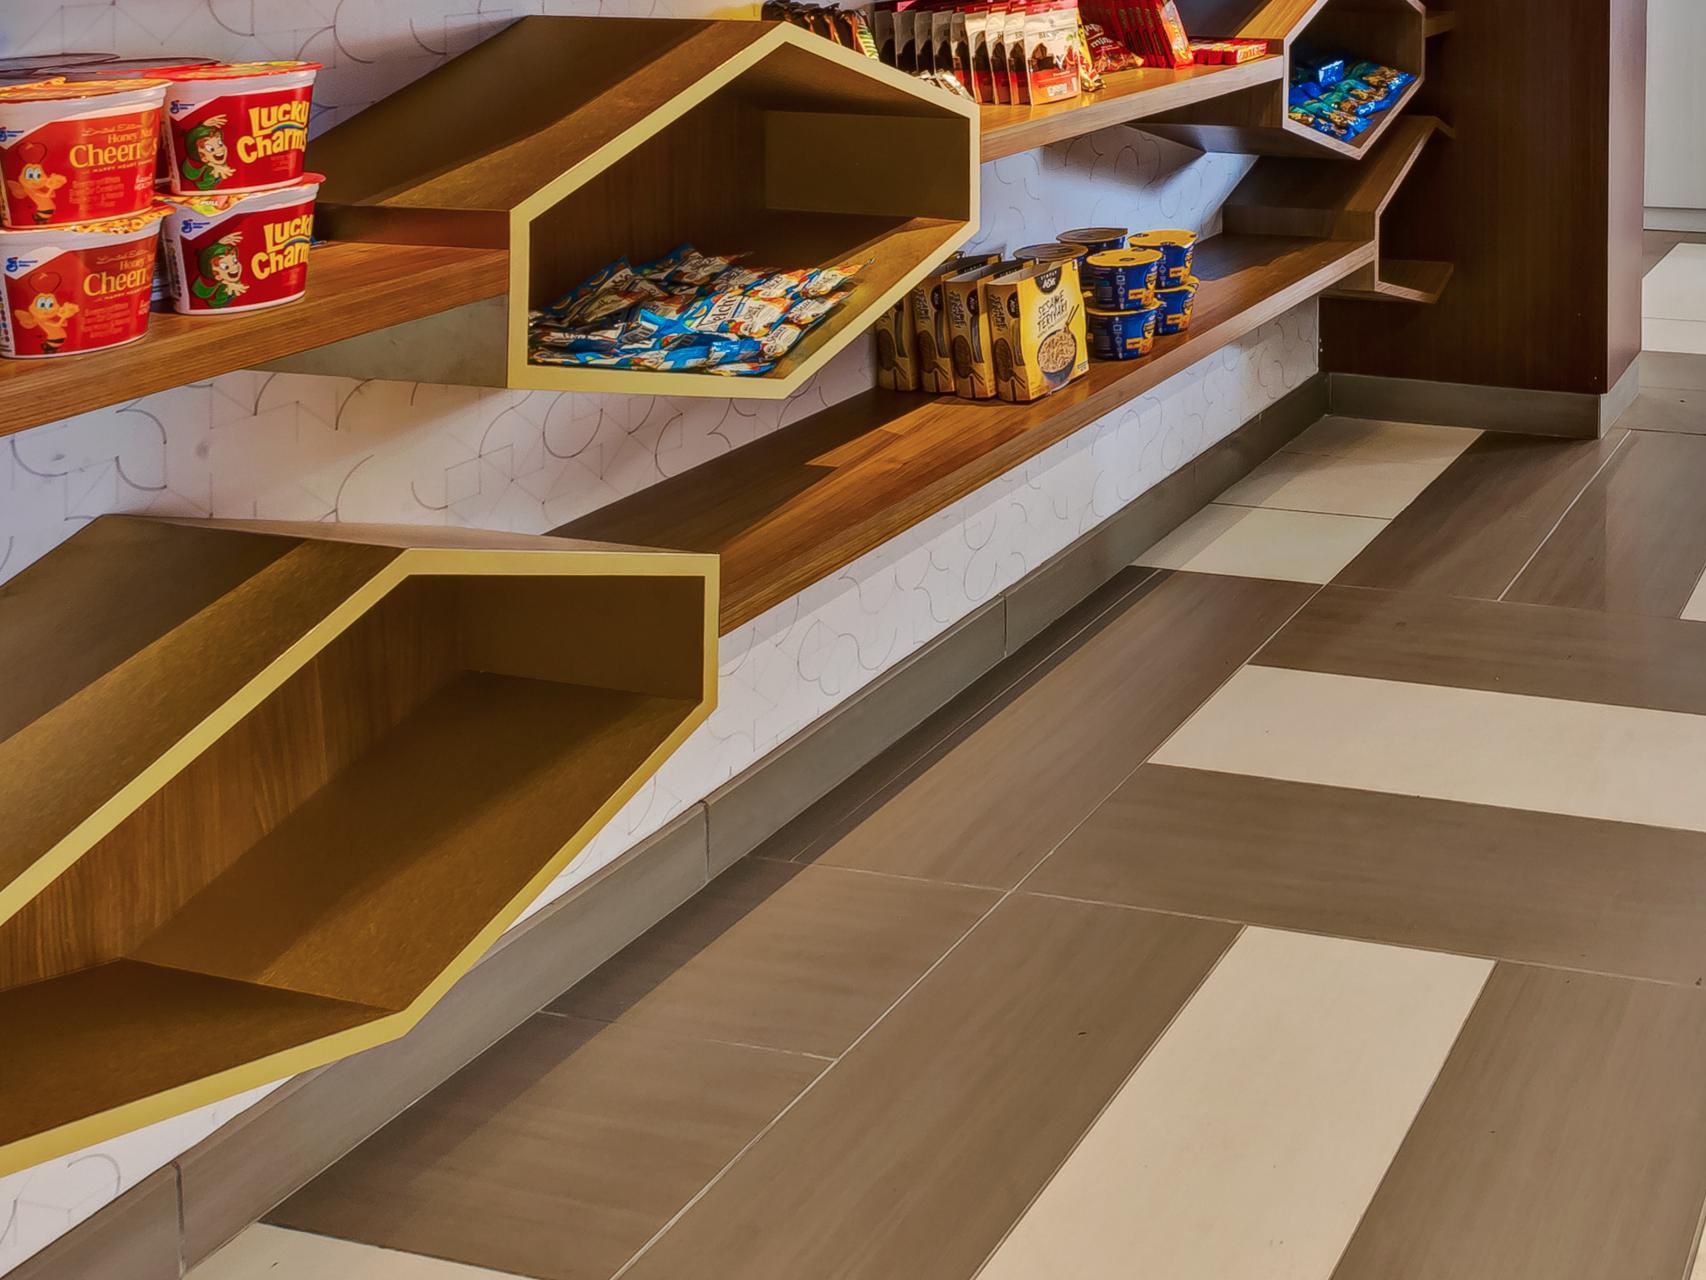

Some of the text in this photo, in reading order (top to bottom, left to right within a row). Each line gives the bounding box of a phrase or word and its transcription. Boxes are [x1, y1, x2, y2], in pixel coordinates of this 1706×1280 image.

[249, 100, 310, 137] Lucky
[237, 128, 308, 164] Charms
[251, 242, 310, 280] Charm
